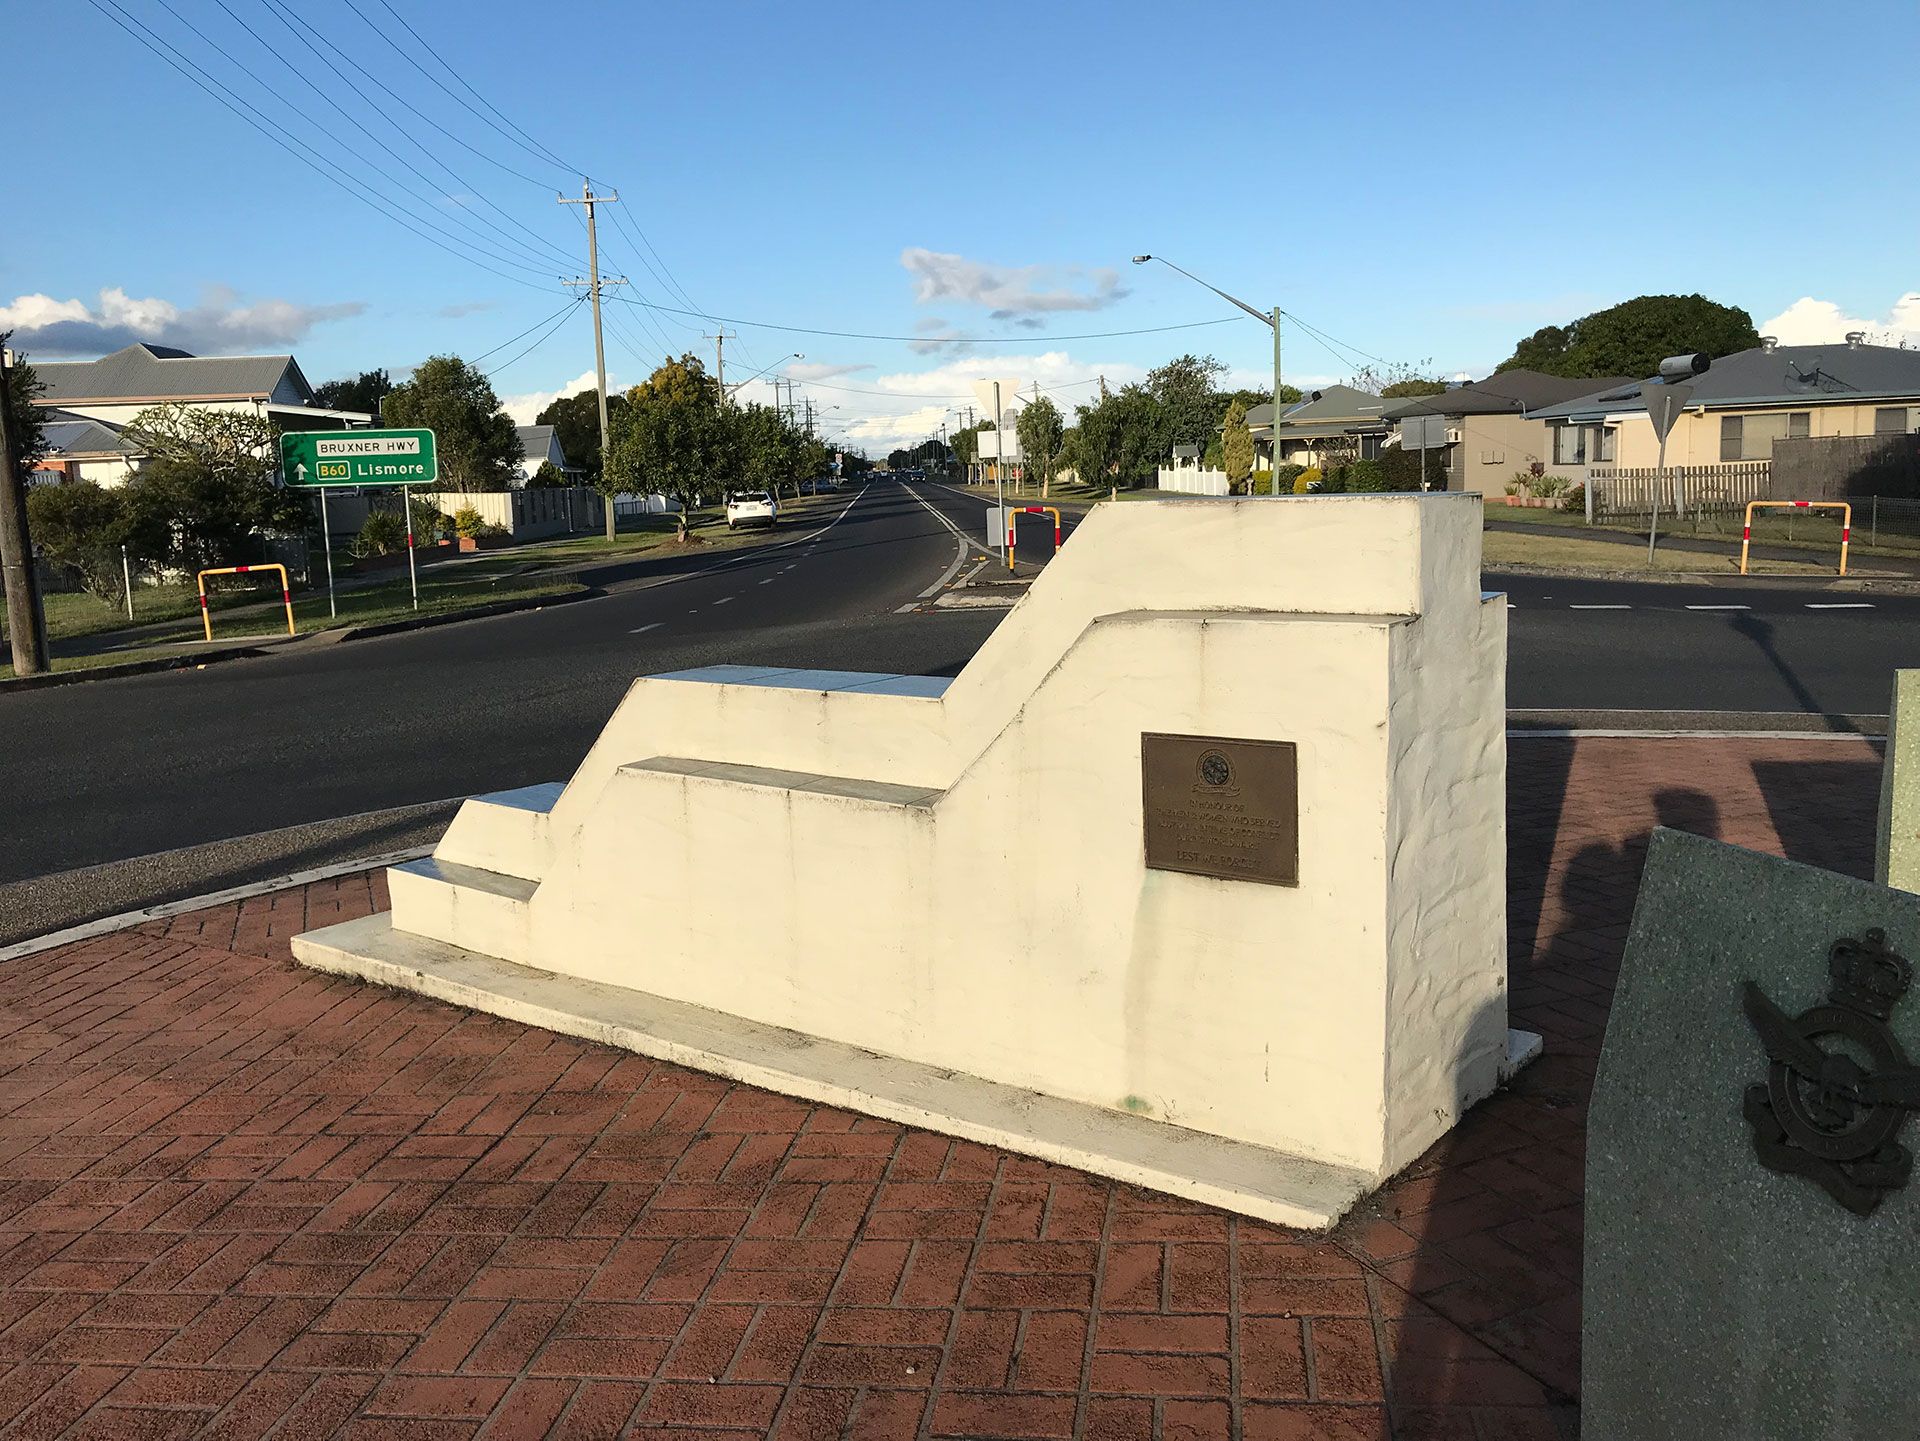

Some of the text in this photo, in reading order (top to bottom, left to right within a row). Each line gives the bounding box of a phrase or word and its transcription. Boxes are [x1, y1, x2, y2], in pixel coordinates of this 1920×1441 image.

[320, 441, 415, 453] BRUXNER HWY
[320, 464, 346, 476] B60
[357, 463, 424, 476] Lismore
[1177, 850, 1199, 862] LEST
